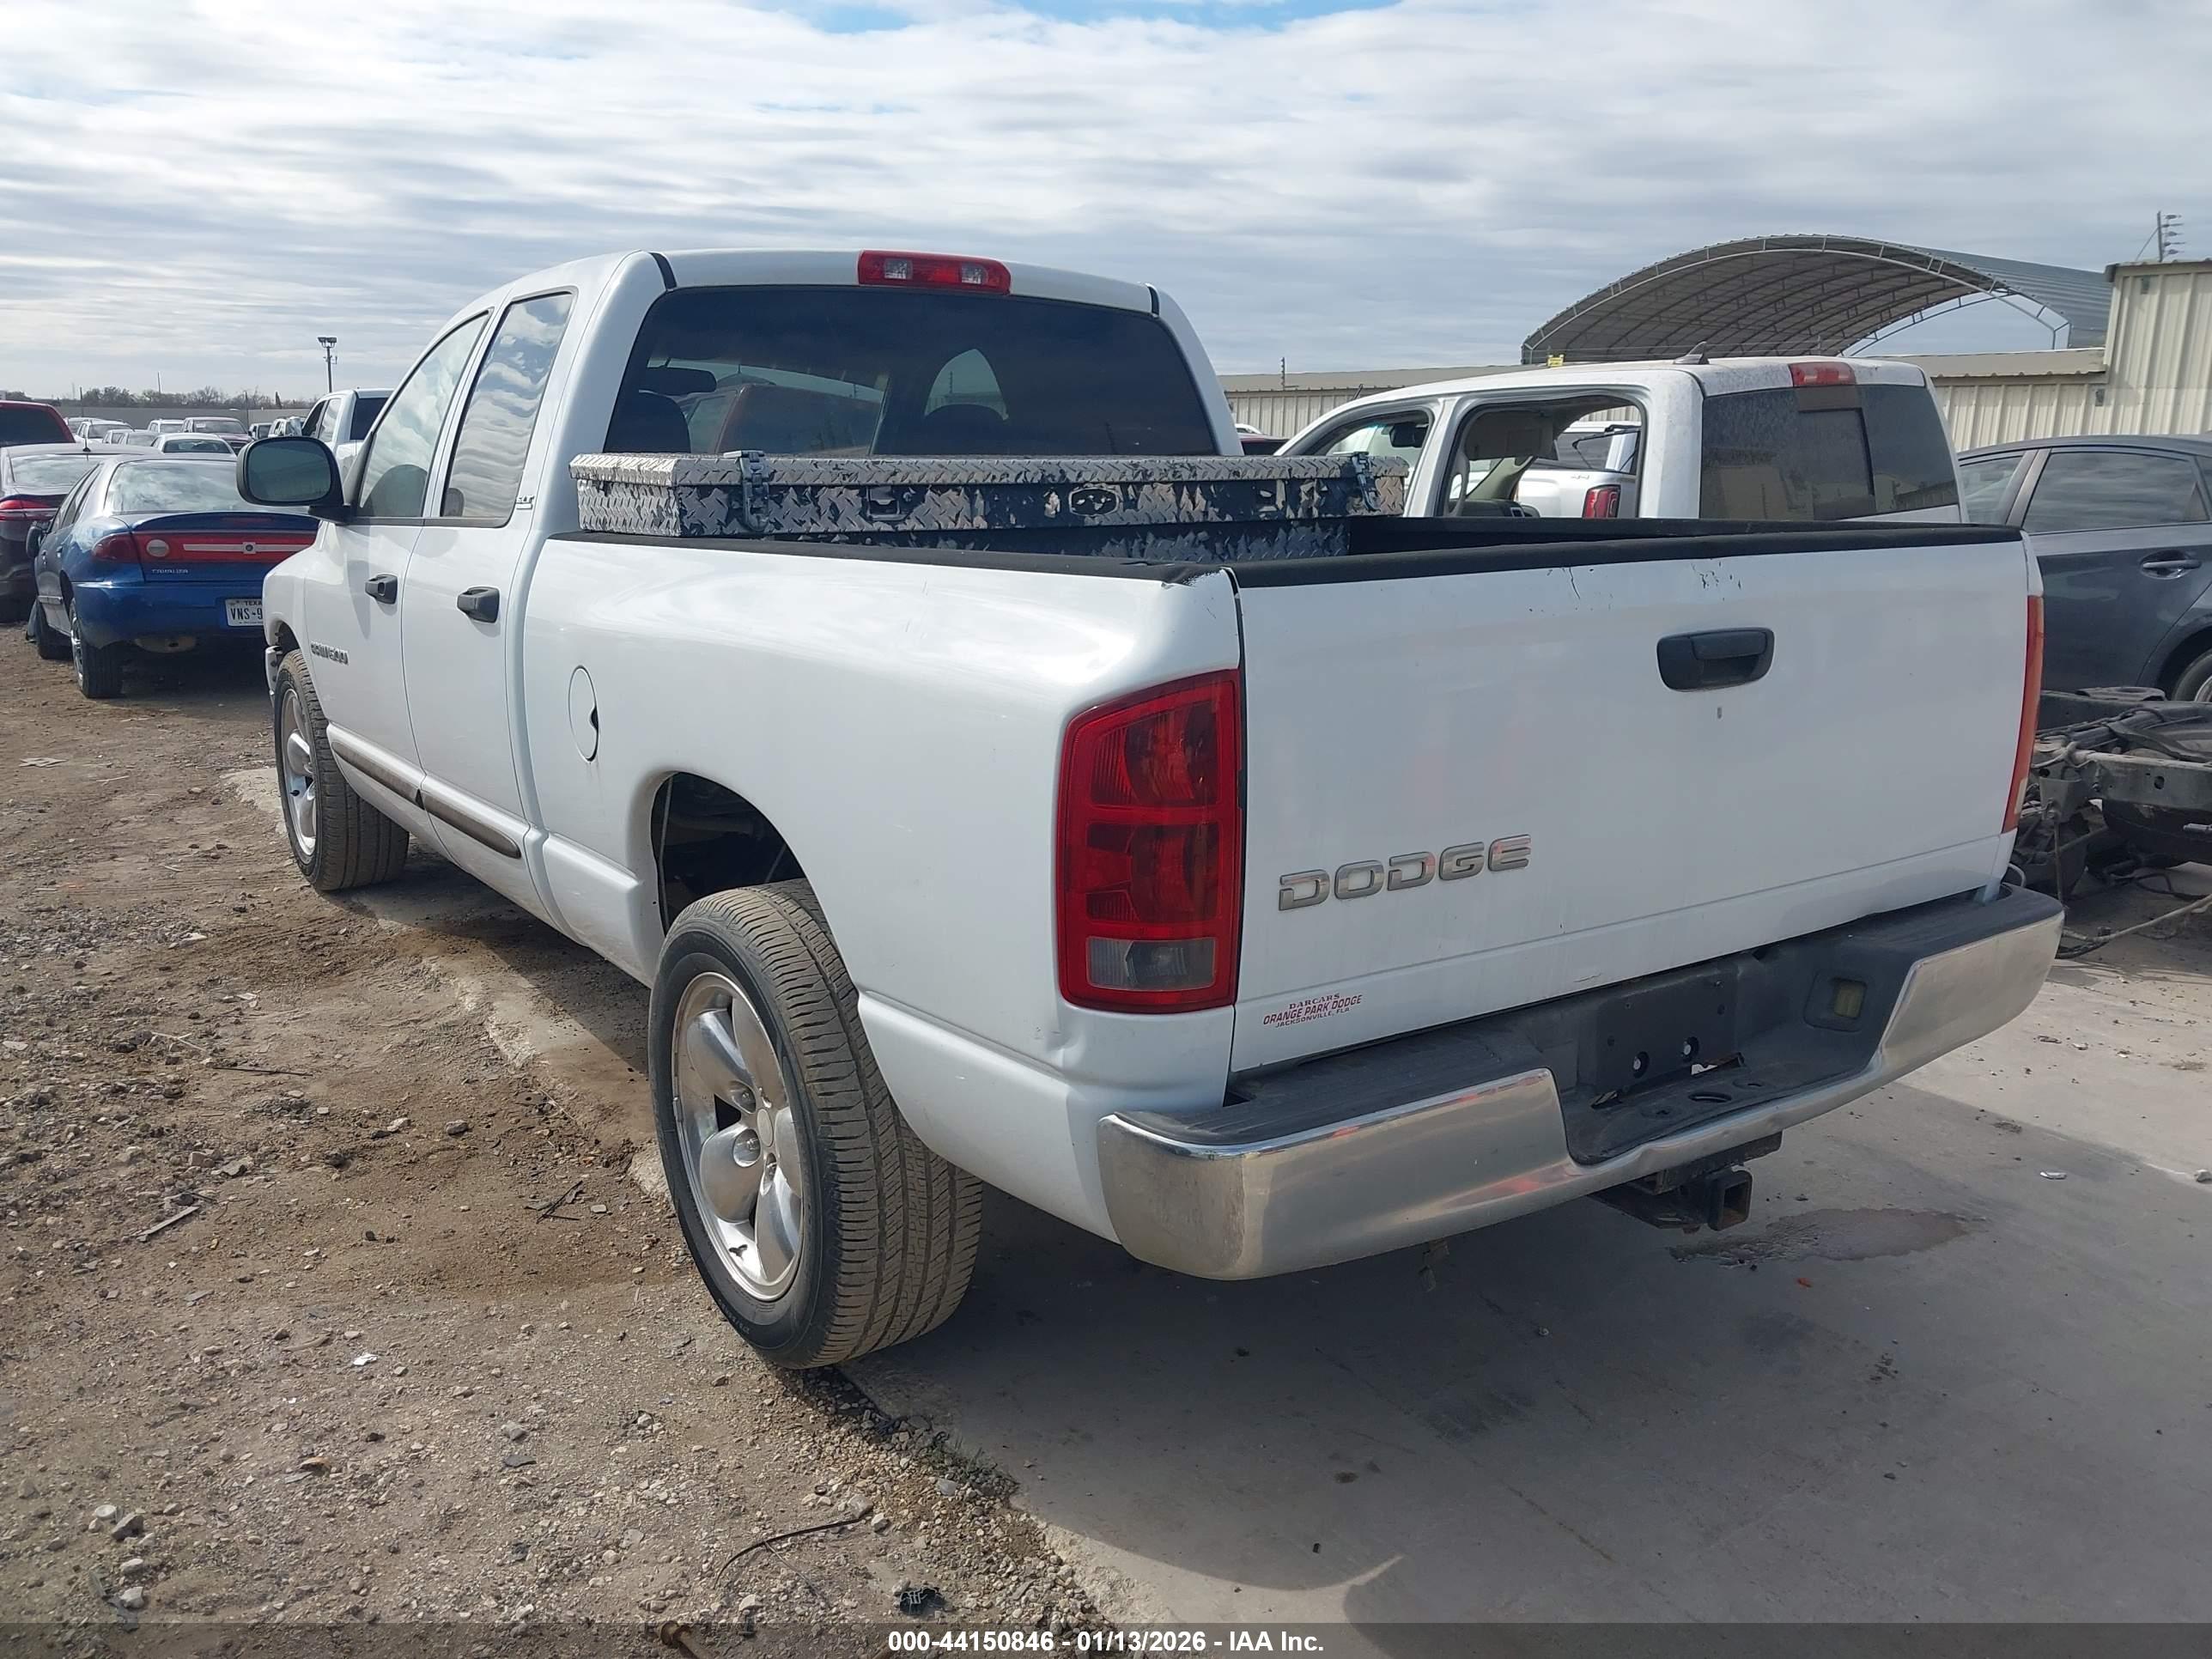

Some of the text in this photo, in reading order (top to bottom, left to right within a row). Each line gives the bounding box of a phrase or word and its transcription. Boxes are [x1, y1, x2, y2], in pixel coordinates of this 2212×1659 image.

[1279, 833, 1532, 911] DODGE
[1263, 994, 1363, 1024] ORANGE PARK DODGE
[1289, 993, 1340, 1009] DARCARS
